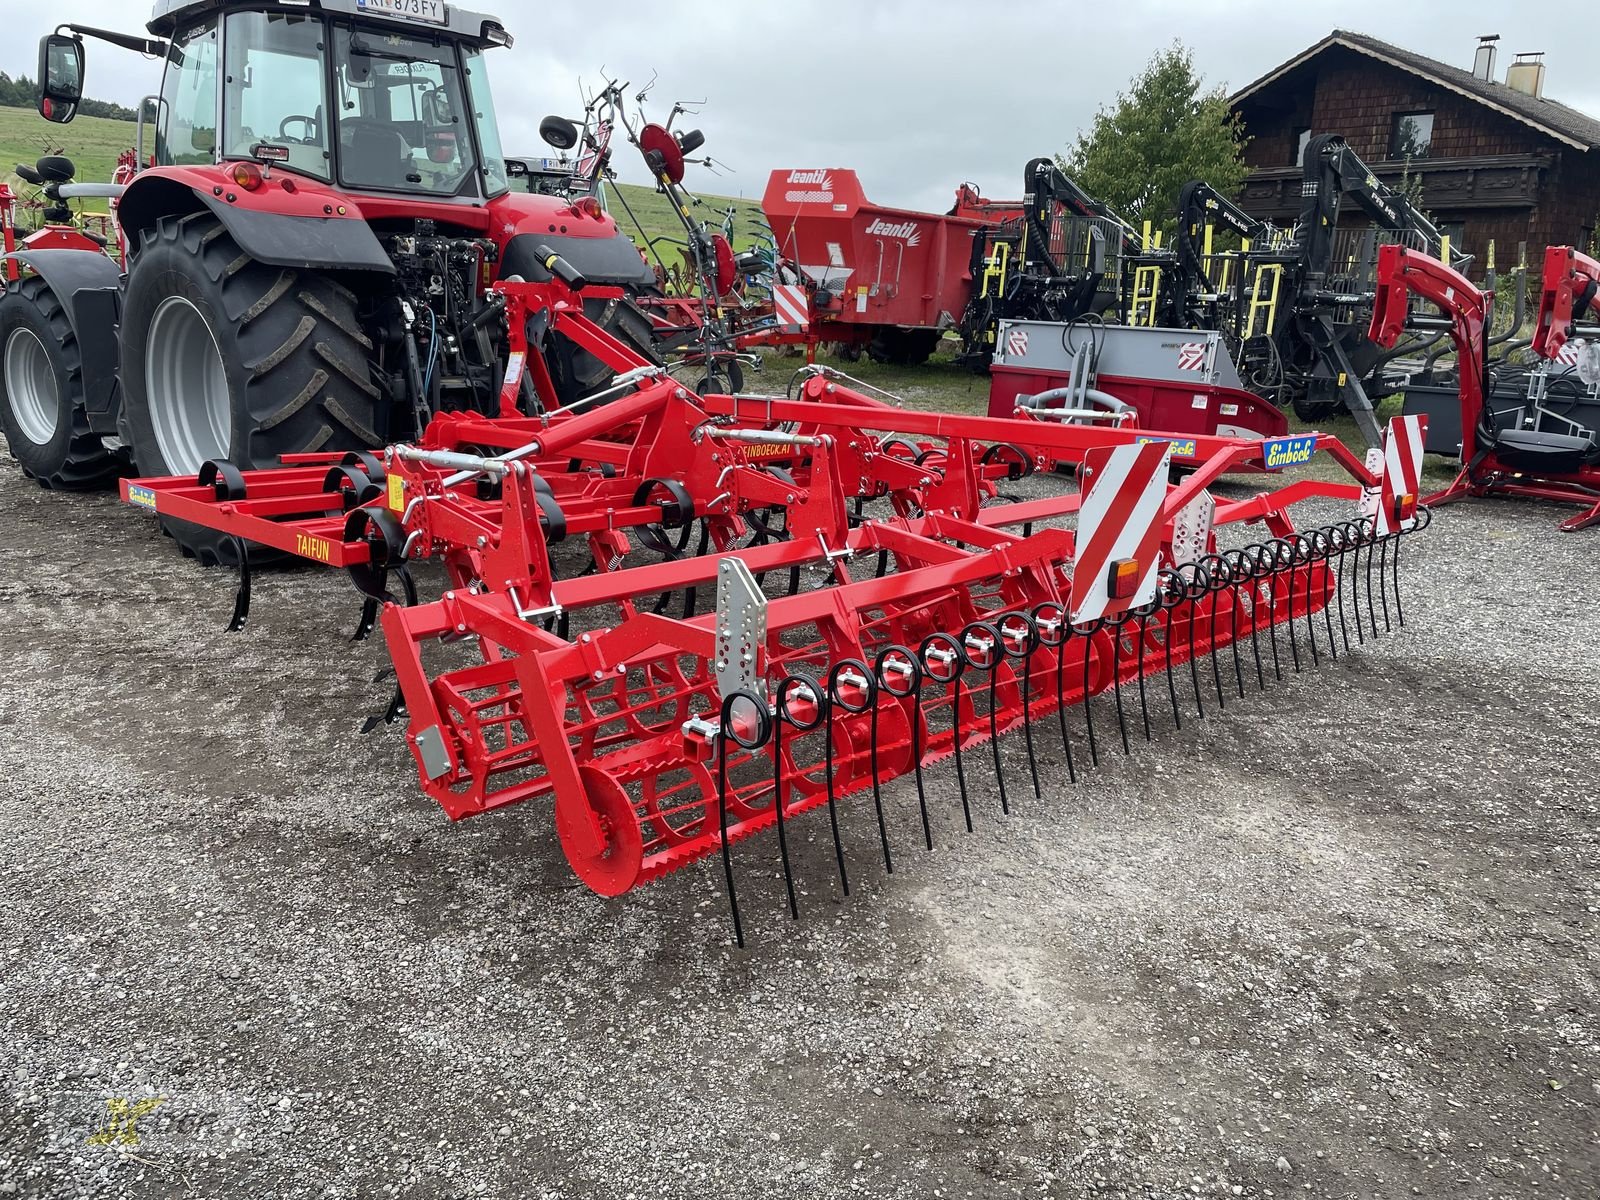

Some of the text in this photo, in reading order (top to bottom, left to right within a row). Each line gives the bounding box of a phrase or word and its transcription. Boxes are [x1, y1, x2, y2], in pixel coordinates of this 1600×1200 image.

[786, 170, 827, 184] Jeantil
[1371, 192, 1396, 219] PALMS
[865, 218, 918, 239] Jeantil
[1223, 211, 1248, 232] PALMS
[1267, 440, 1312, 466] Einböck
[296, 534, 329, 561] TAIFUN
